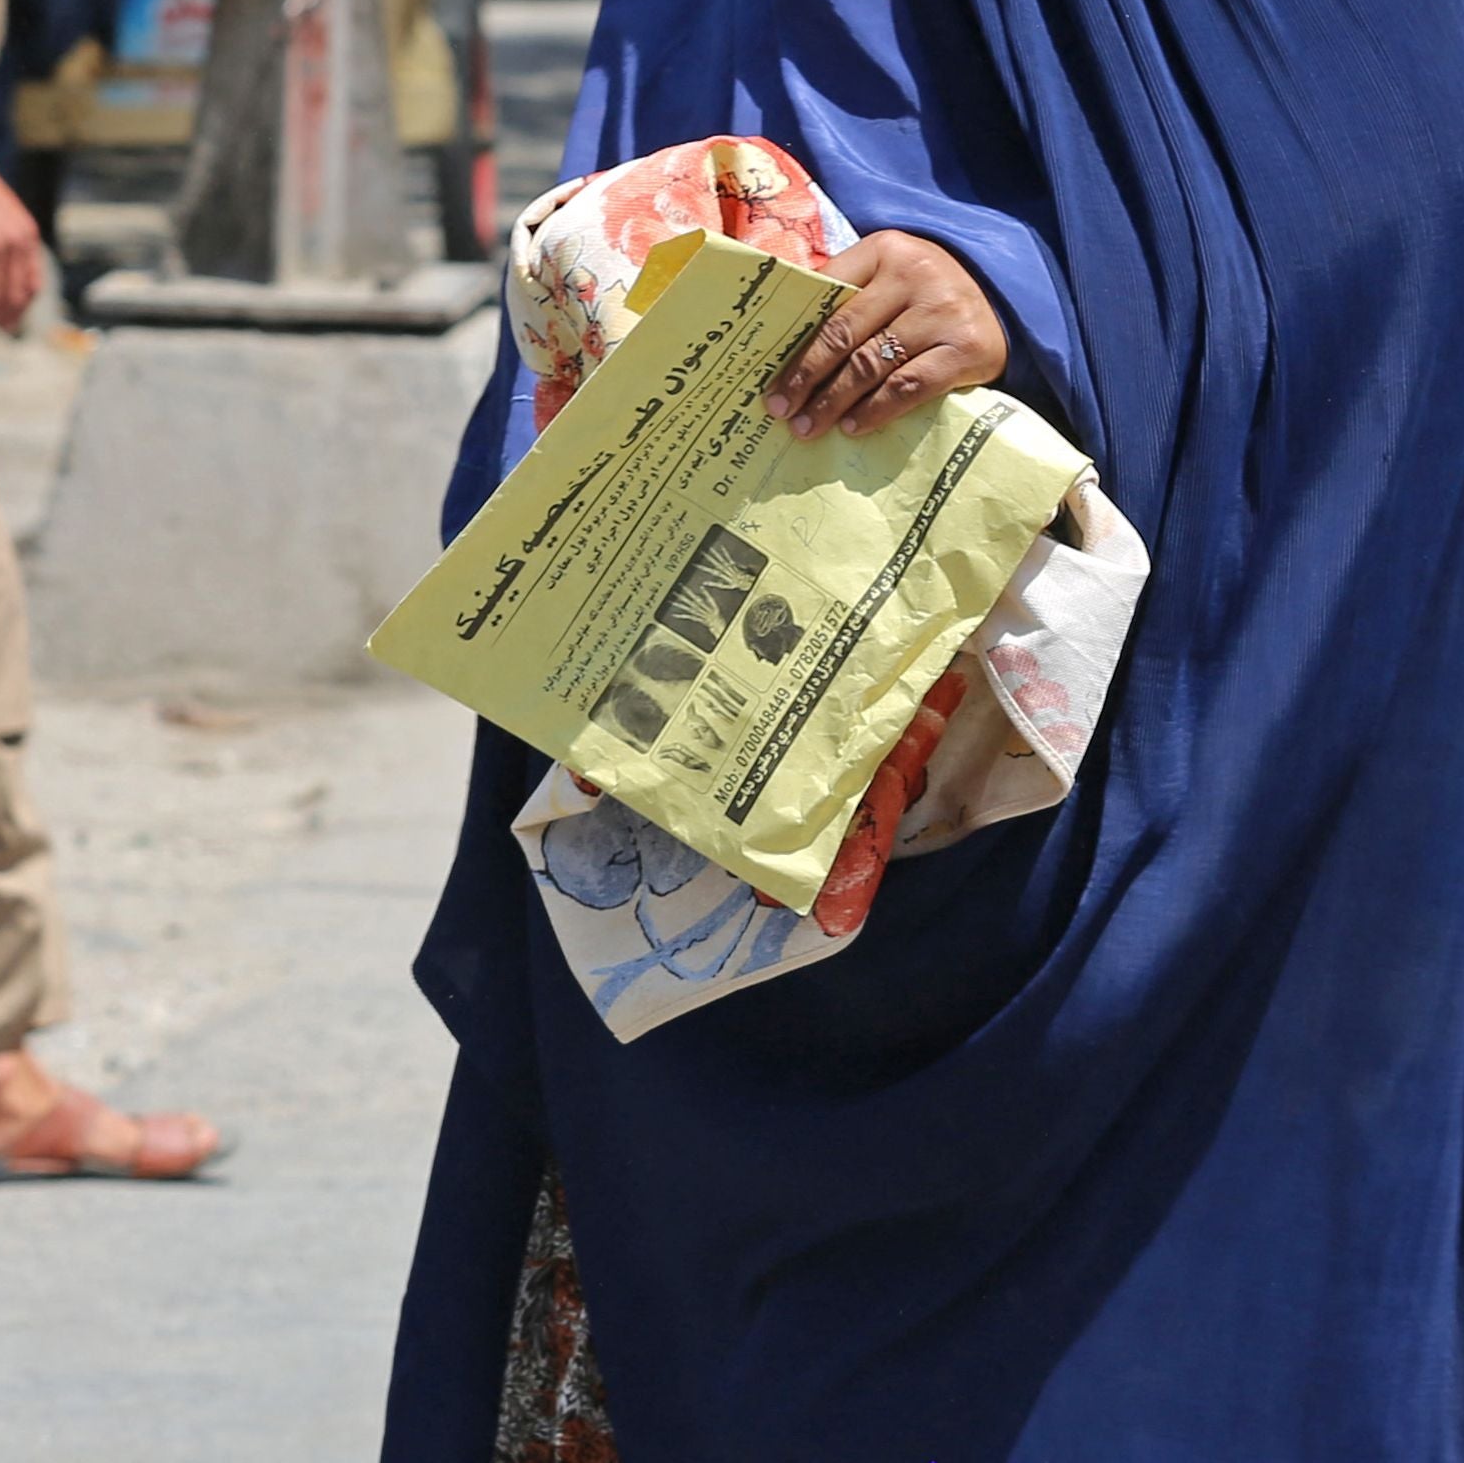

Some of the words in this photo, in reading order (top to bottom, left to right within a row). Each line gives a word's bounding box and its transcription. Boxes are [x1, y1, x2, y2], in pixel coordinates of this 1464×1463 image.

[816, 284, 845, 321] کتور
[664, 320, 733, 395] روغوال
[775, 321, 815, 363] محمد
[738, 361, 780, 407] اشرف
[954, 452, 965, 462] د
[522, 451, 614, 553] تشخیصیه
[711, 473, 737, 497] Dr.
[456, 554, 525, 640] کلینیک
[833, 628, 852, 657] دوهم
[815, 654, 836, 680] منزل
[712, 768, 742, 805] Mob:
[734, 687, 790, 767] 0700048449
[789, 599, 848, 680] 0782051572
